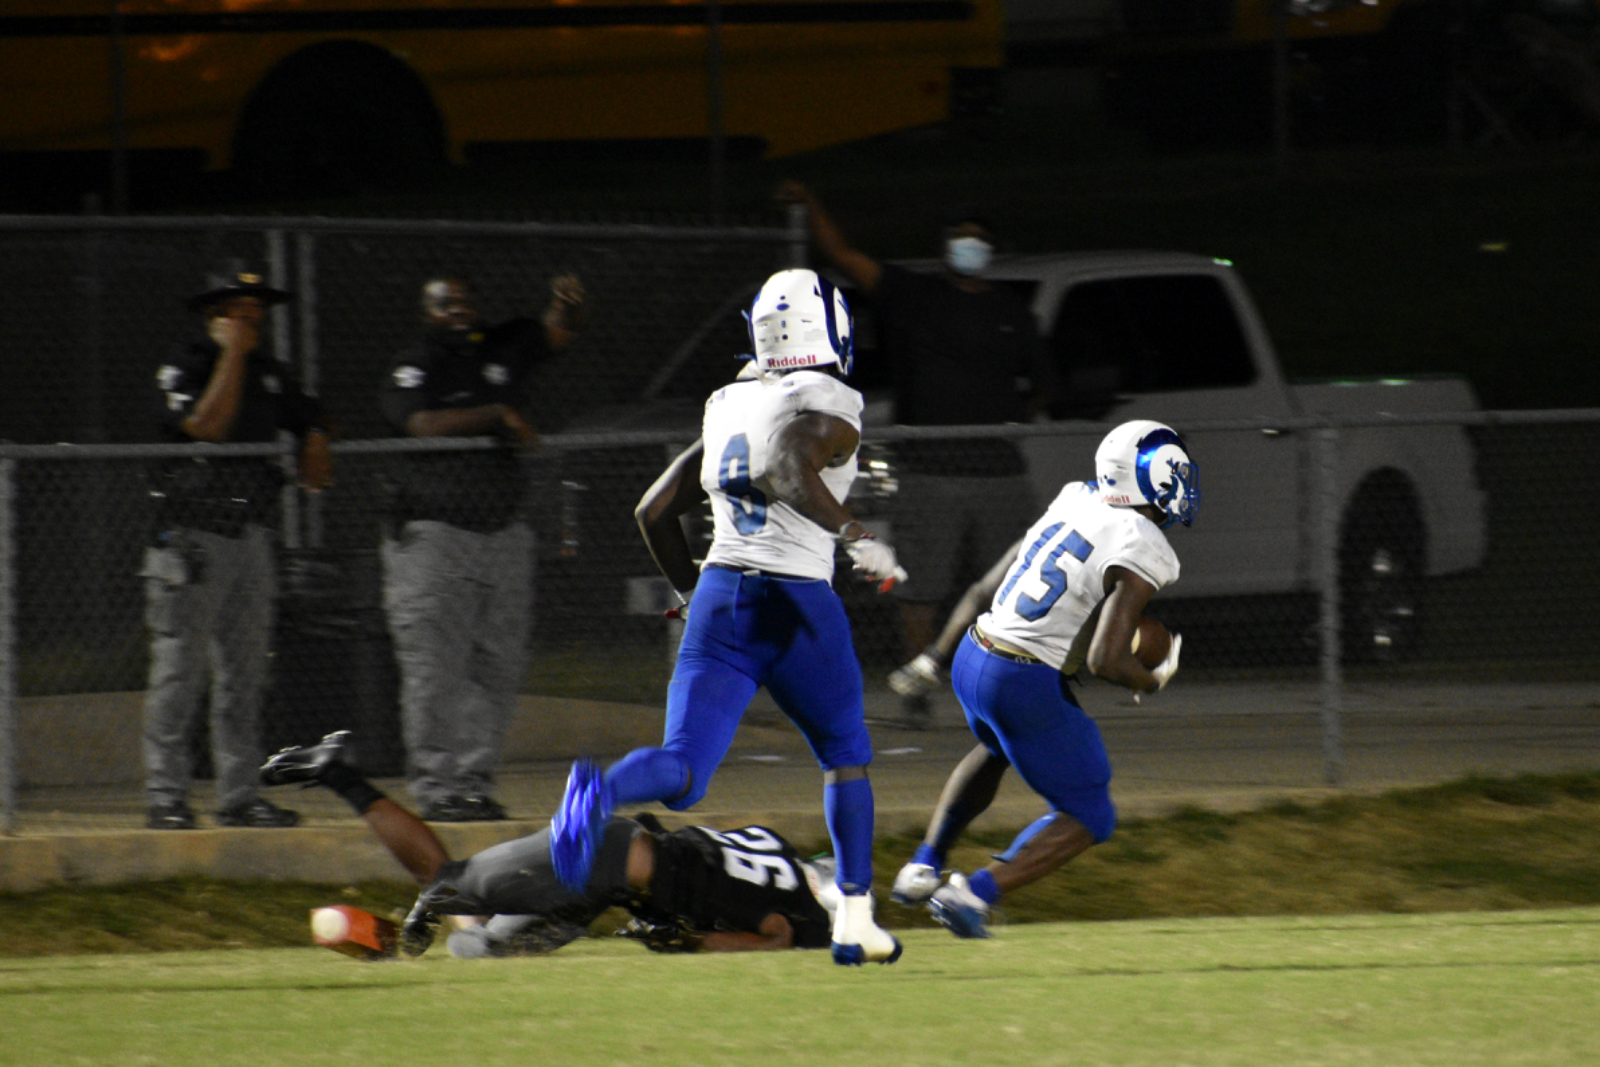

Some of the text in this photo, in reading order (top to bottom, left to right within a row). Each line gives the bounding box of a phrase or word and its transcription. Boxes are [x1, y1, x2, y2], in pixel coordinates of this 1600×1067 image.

[767, 354, 817, 369] Riddell
[718, 431, 767, 537] 8
[997, 521, 1095, 623] 15
[697, 825, 799, 891] 26
